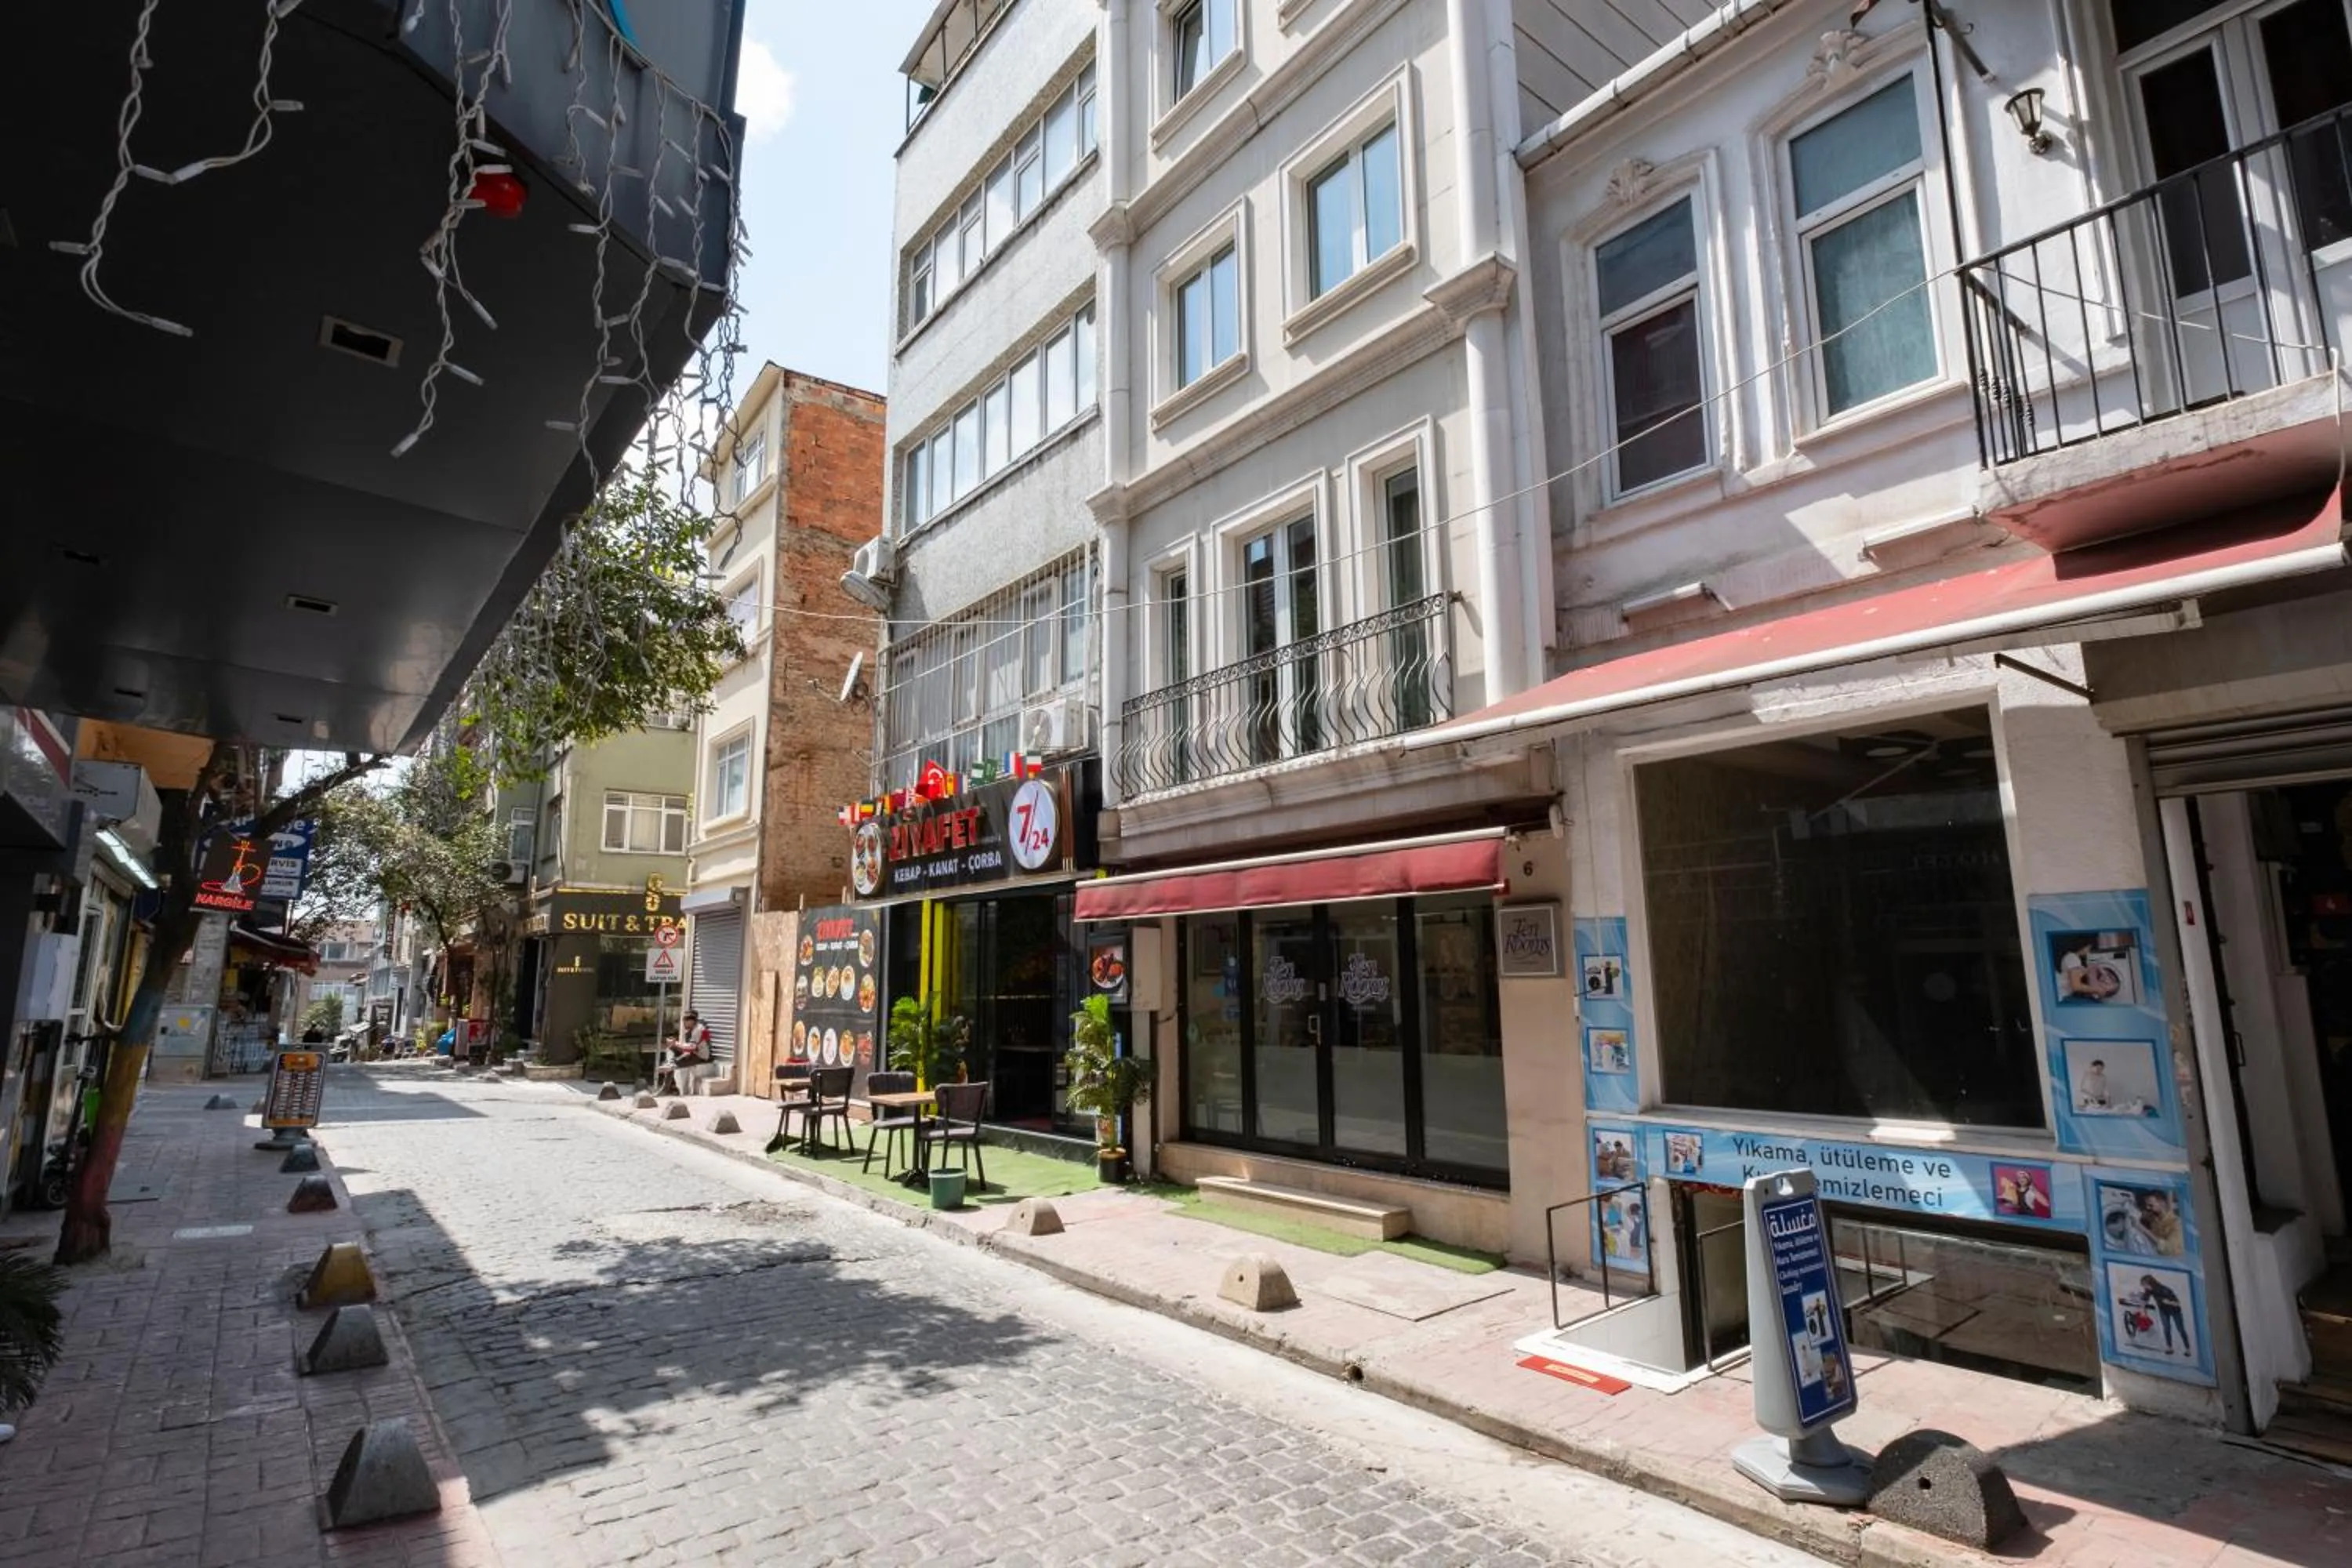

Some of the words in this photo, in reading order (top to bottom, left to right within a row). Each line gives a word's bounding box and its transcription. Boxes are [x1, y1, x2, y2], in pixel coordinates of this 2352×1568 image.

[894, 867, 921, 884] KEBAP
[928, 859, 959, 877] KANAT
[967, 851, 1003, 874] ÇORBA
[1523, 860, 1534, 877] 6
[563, 913, 620, 931] SUIT
[625, 915, 641, 932] &
[1732, 1137, 1813, 1167] Yıkama,
[1820, 1145, 1915, 1174] ütüleme
[1922, 1160, 1951, 1178] ve
[1769, 1208, 1817, 1237] مغسلة
